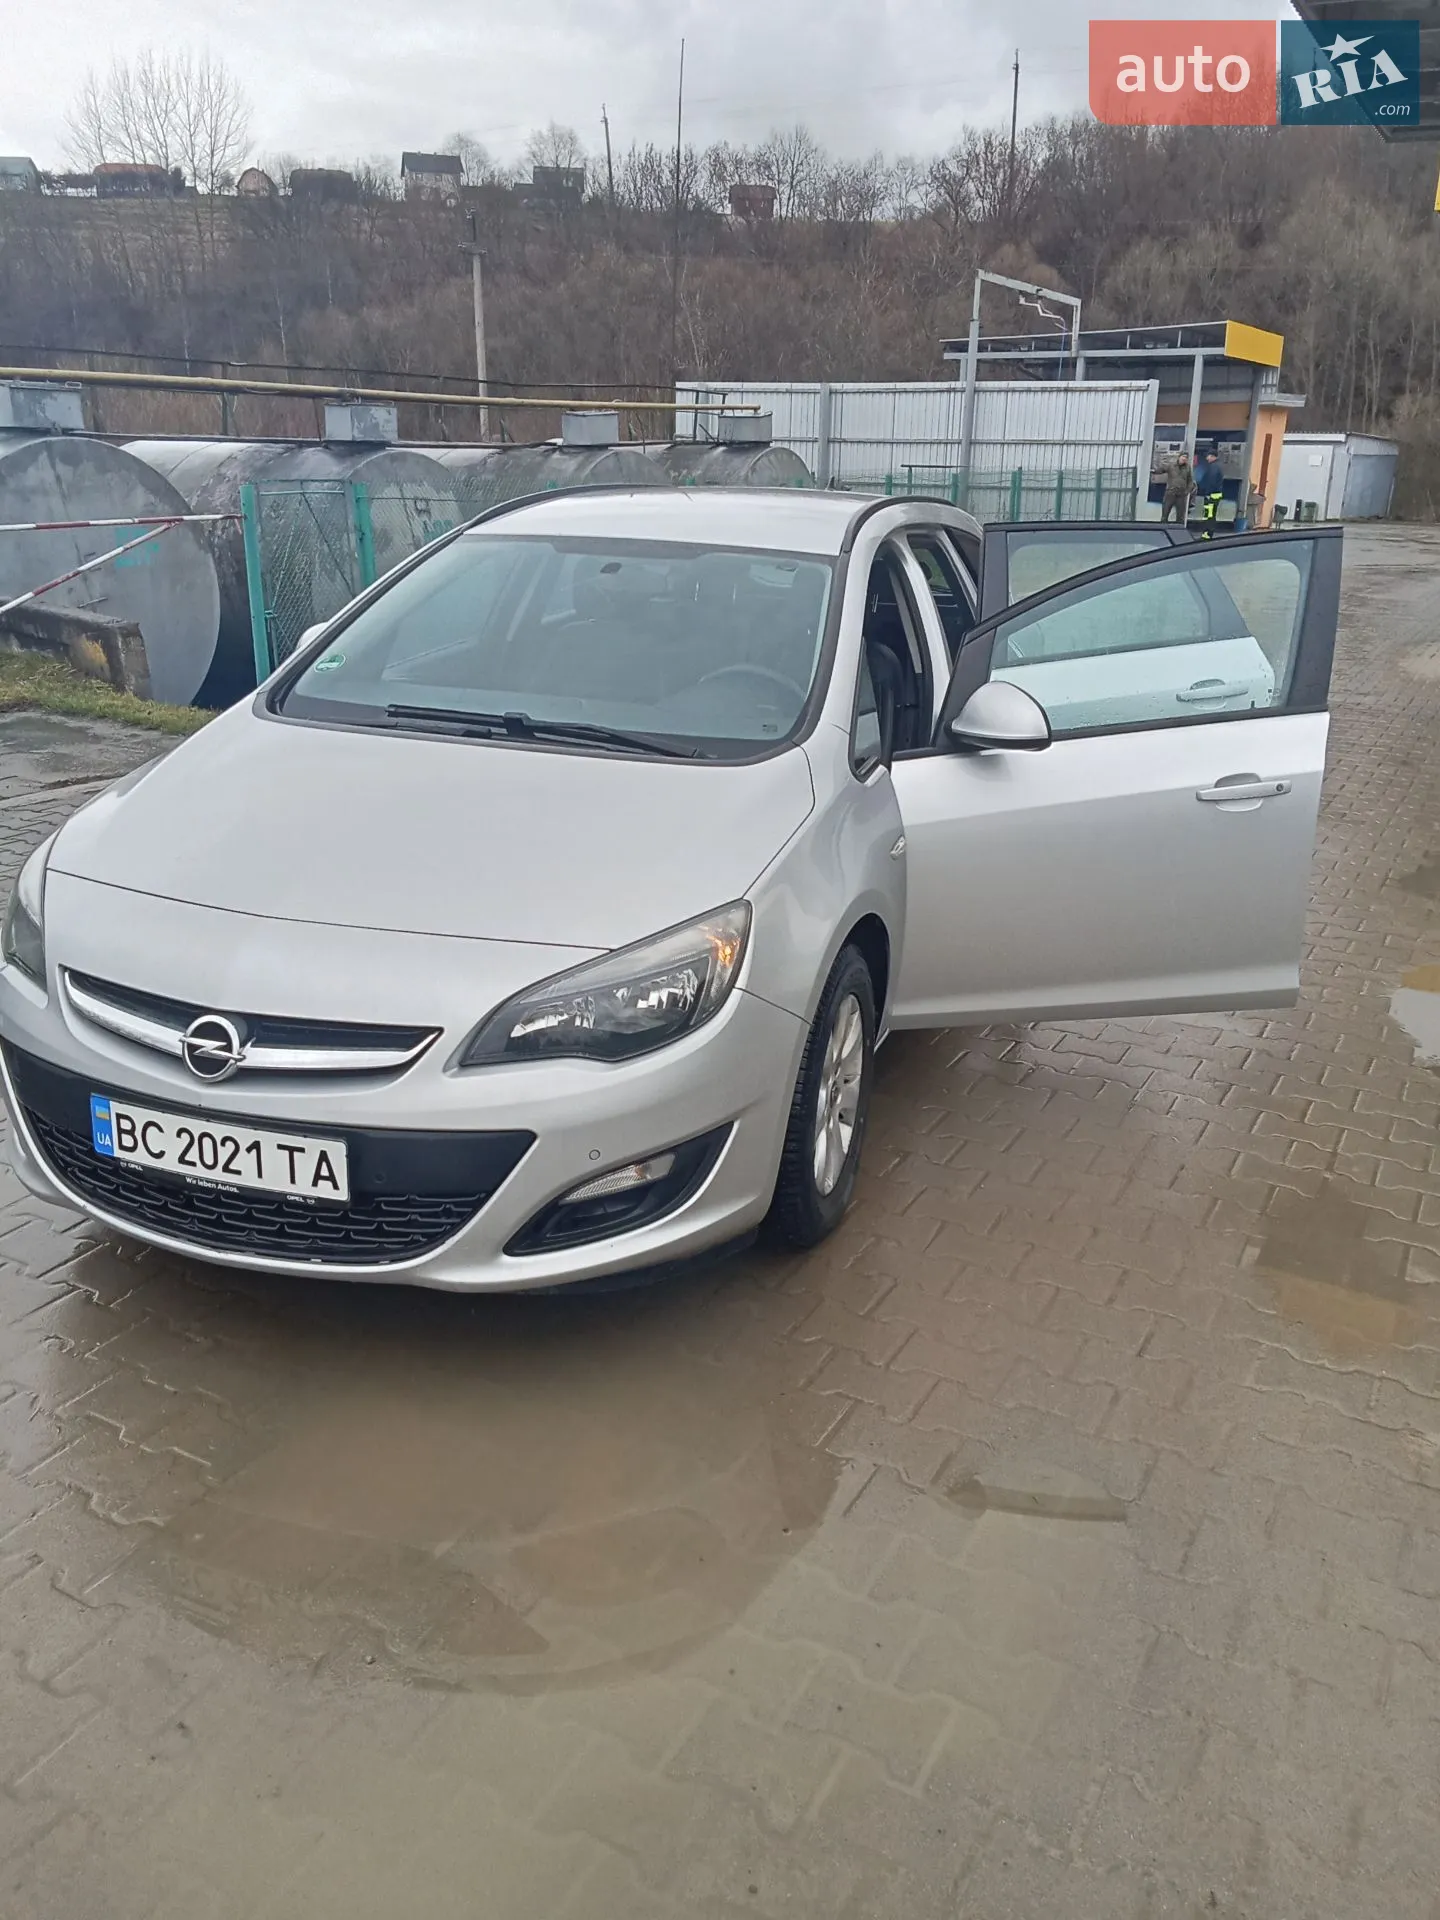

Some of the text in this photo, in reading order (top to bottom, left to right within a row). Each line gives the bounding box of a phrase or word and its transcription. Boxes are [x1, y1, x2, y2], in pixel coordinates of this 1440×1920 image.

[97, 1132, 112, 1147] UA
[115, 1112, 340, 1191] BC 2021 TA
[286, 1194, 304, 1203] OPEL
